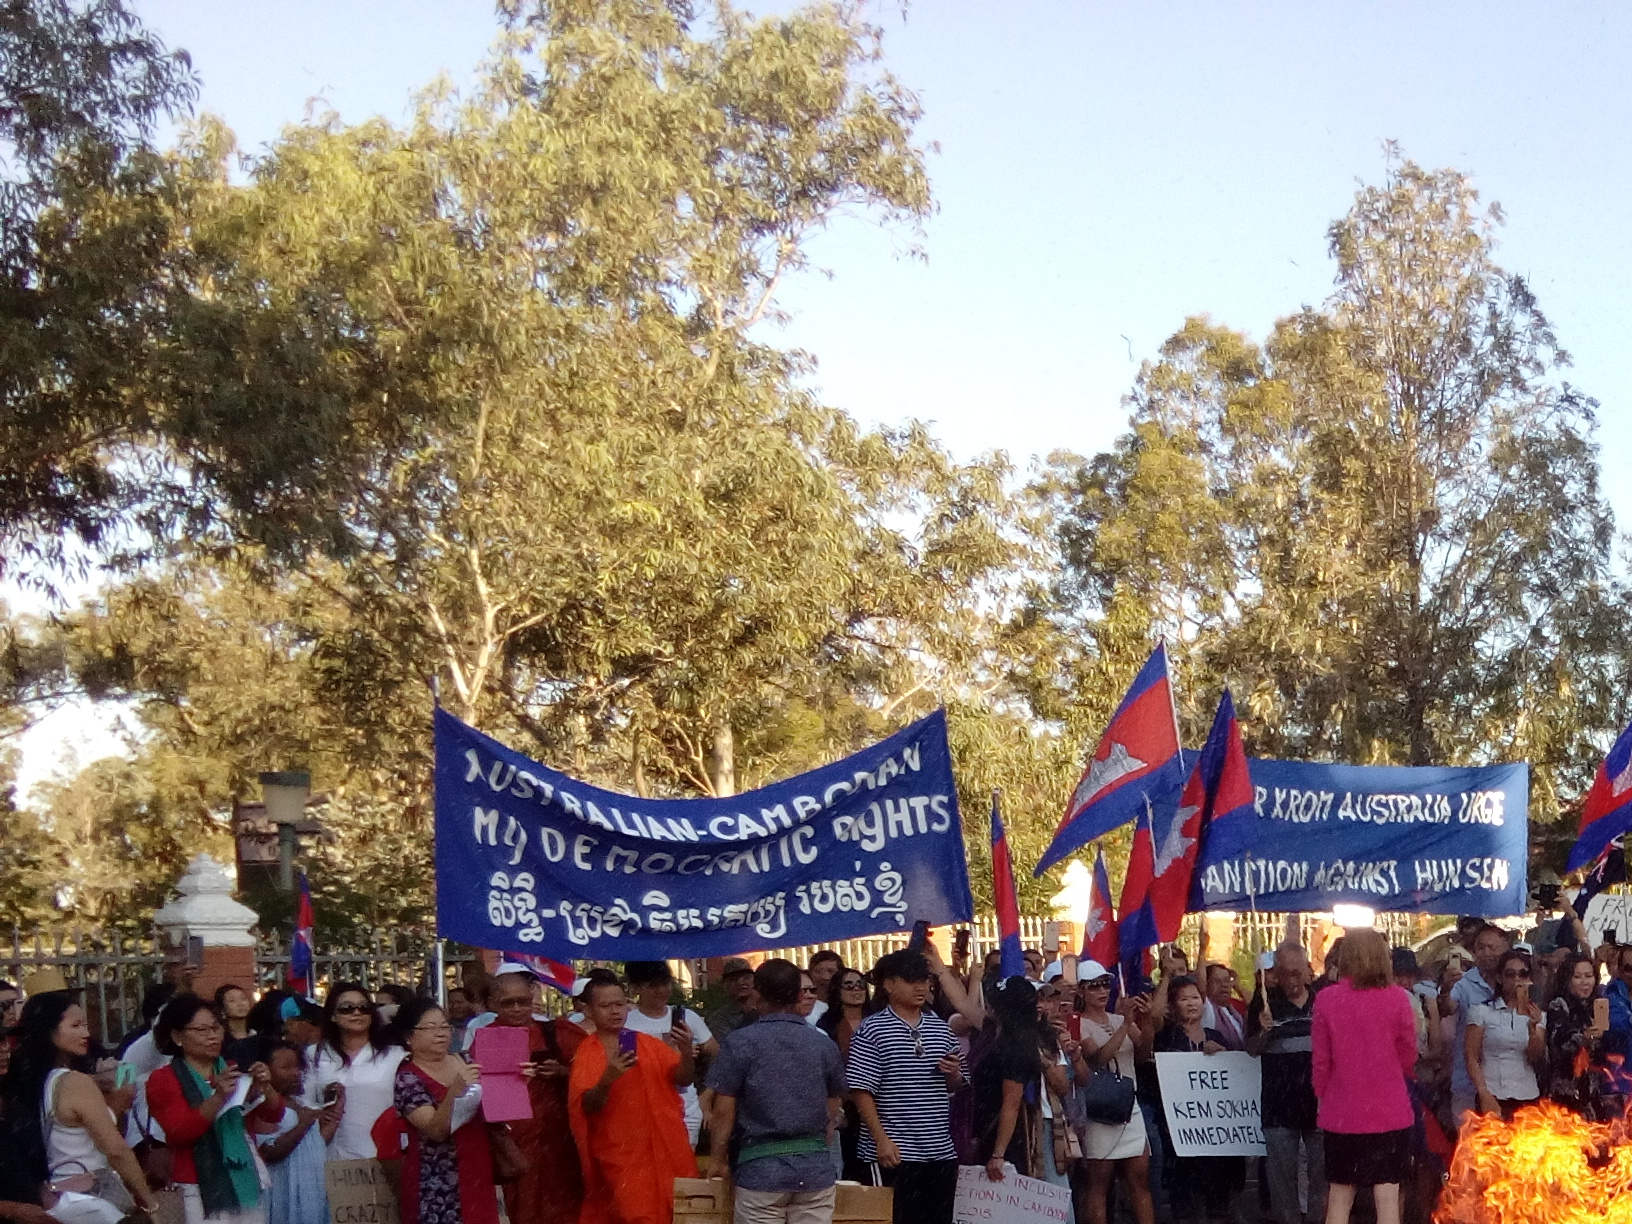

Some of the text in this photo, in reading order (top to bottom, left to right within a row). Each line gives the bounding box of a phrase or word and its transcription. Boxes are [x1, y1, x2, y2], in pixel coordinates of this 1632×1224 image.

[1337, 790, 1452, 826] AUSTRALIA
[1458, 790, 1506, 827] URGE
[1313, 857, 1401, 895] AGAINST
[1414, 857, 1462, 891] HUN
[1464, 857, 1510, 891] SEN
[1188, 1070, 1230, 1091] FREE
[1173, 1099, 1261, 1120] KEM SOKHA
